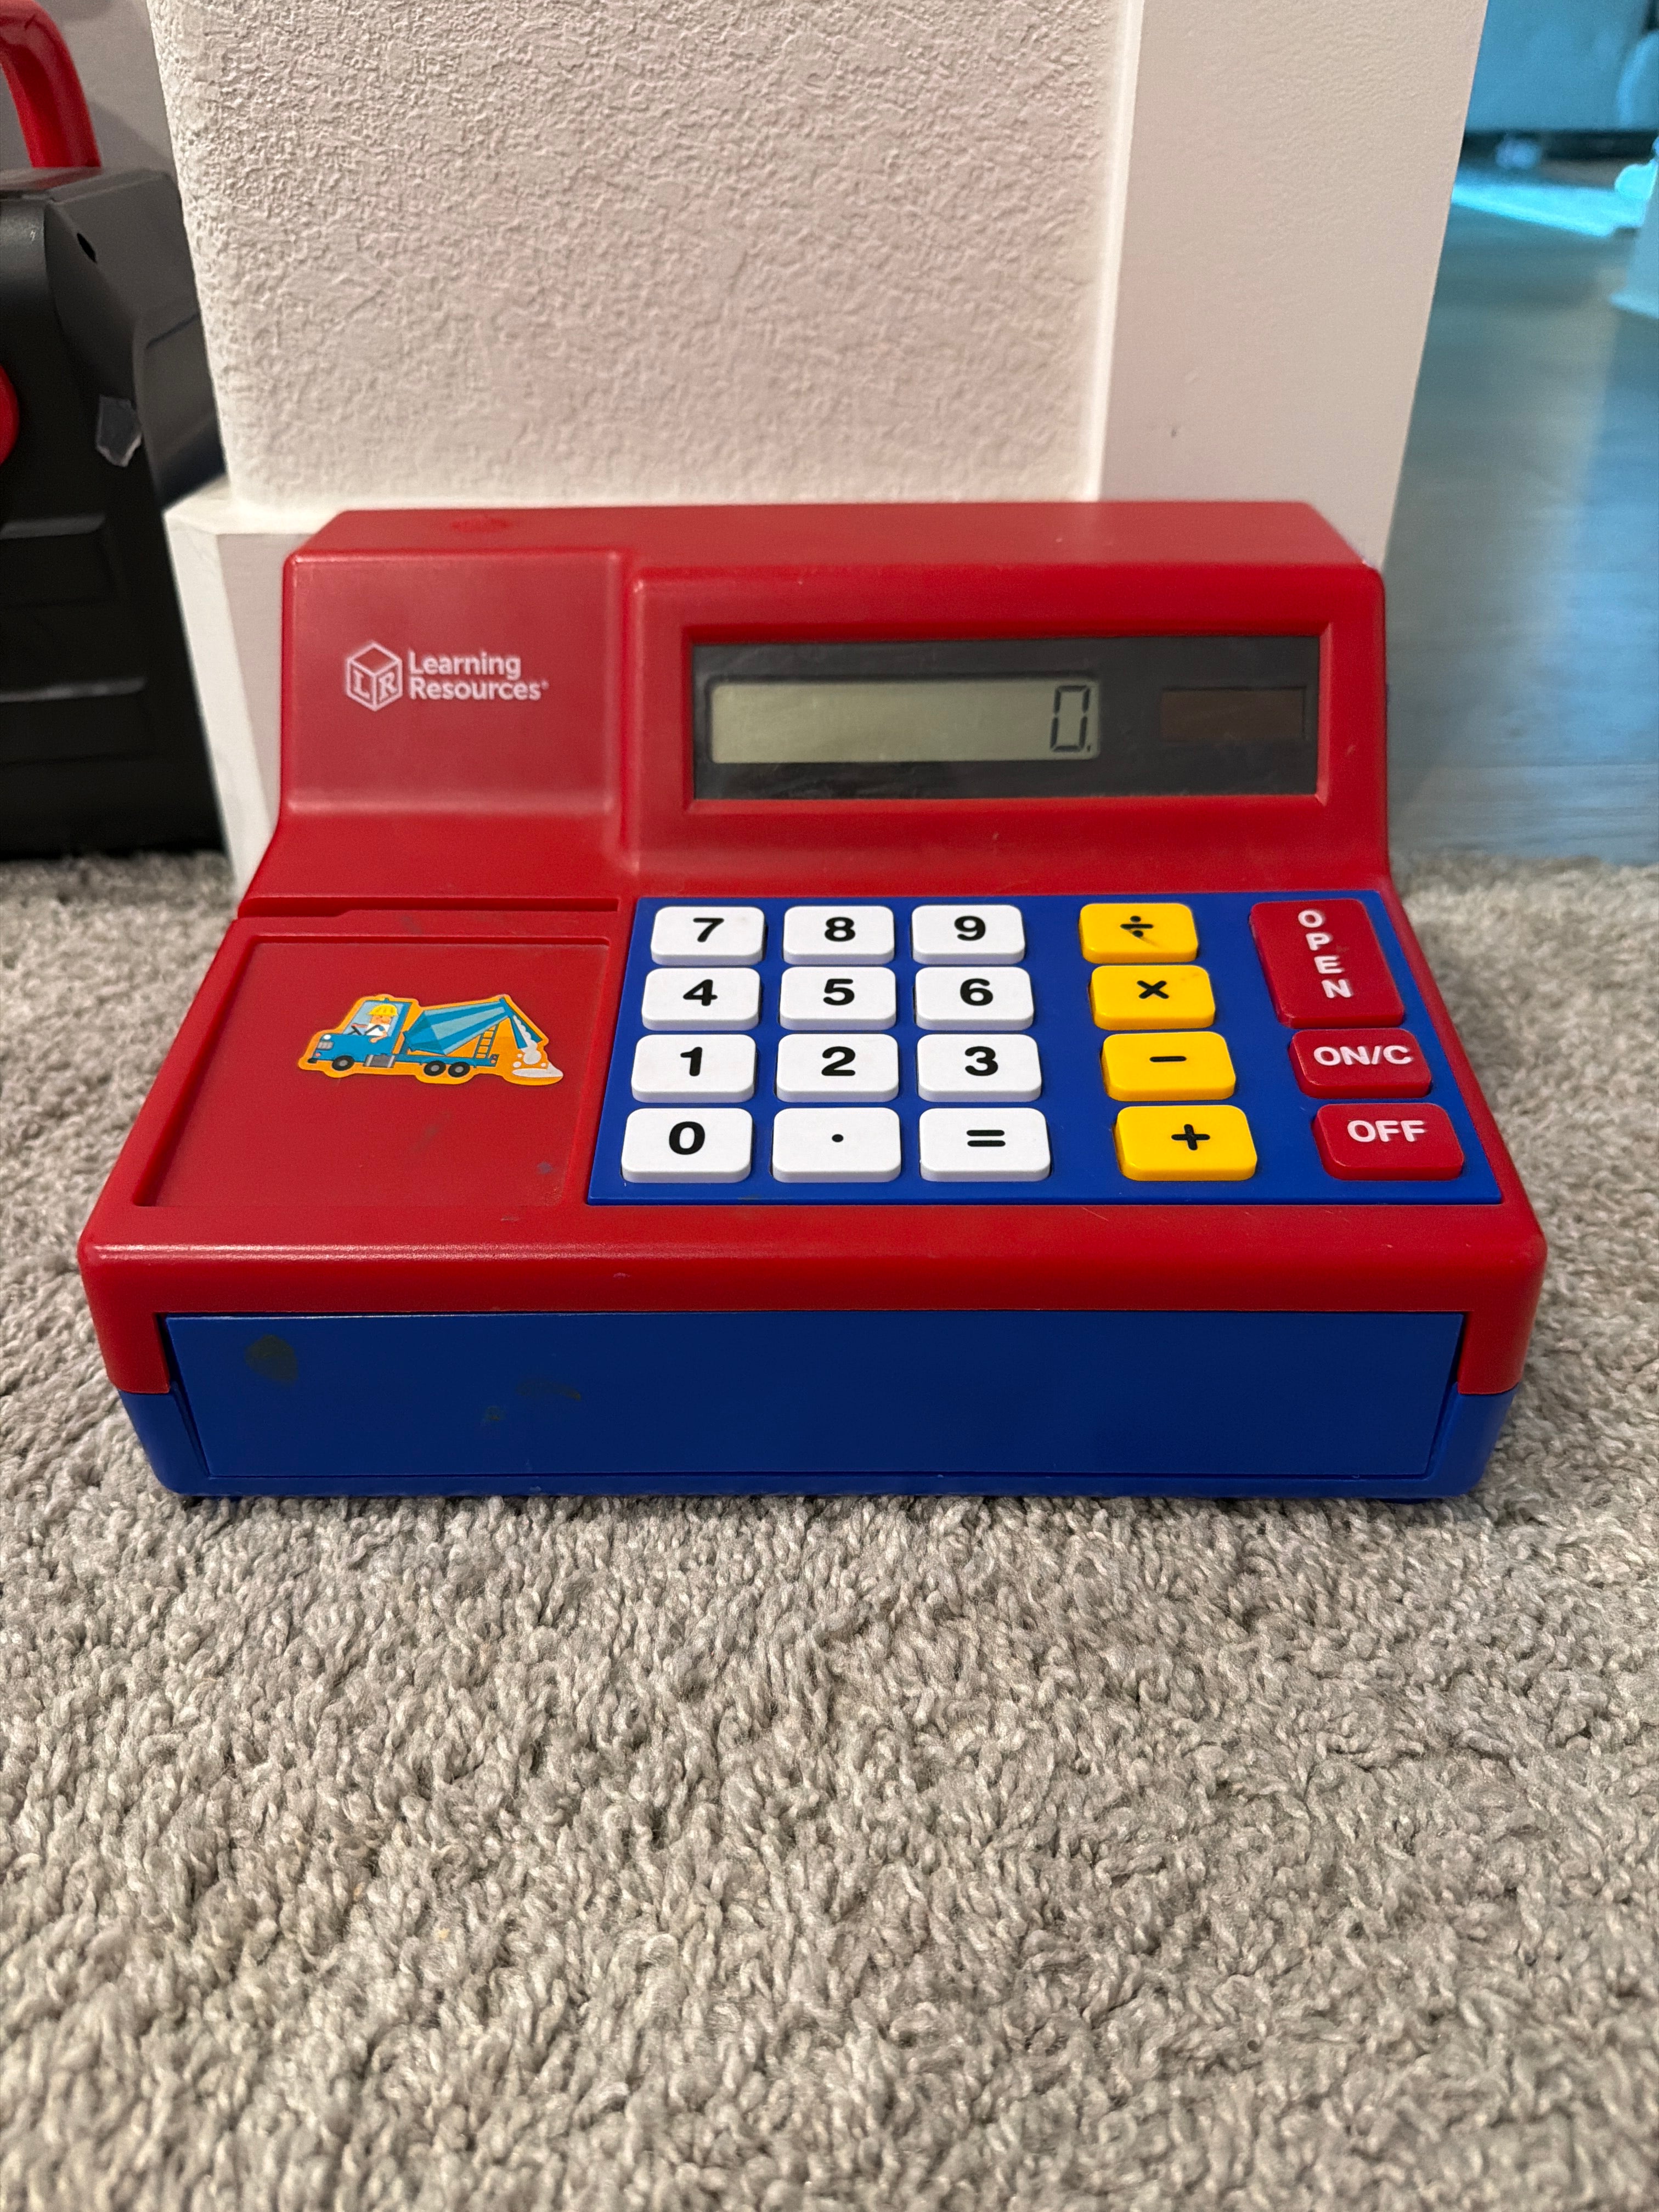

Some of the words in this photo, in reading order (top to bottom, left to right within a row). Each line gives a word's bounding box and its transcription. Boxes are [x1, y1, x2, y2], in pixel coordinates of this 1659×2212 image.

[408, 649, 522, 681] Learning
[693, 917, 725, 943] 7
[824, 916, 856, 943] 8
[953, 915, 986, 941] 9
[1297, 909, 1353, 999] OPEN
[682, 978, 718, 1007] 4
[822, 978, 855, 1006] 5
[959, 978, 994, 1007] 6
[680, 1046, 703, 1077] 1
[821, 1045, 856, 1077] 2
[964, 1045, 999, 1077] 3
[1313, 1045, 1413, 1066] ON/C
[668, 1120, 706, 1156] 0
[1170, 1123, 1211, 1152] +
[1346, 1119, 1427, 1143] OFF
